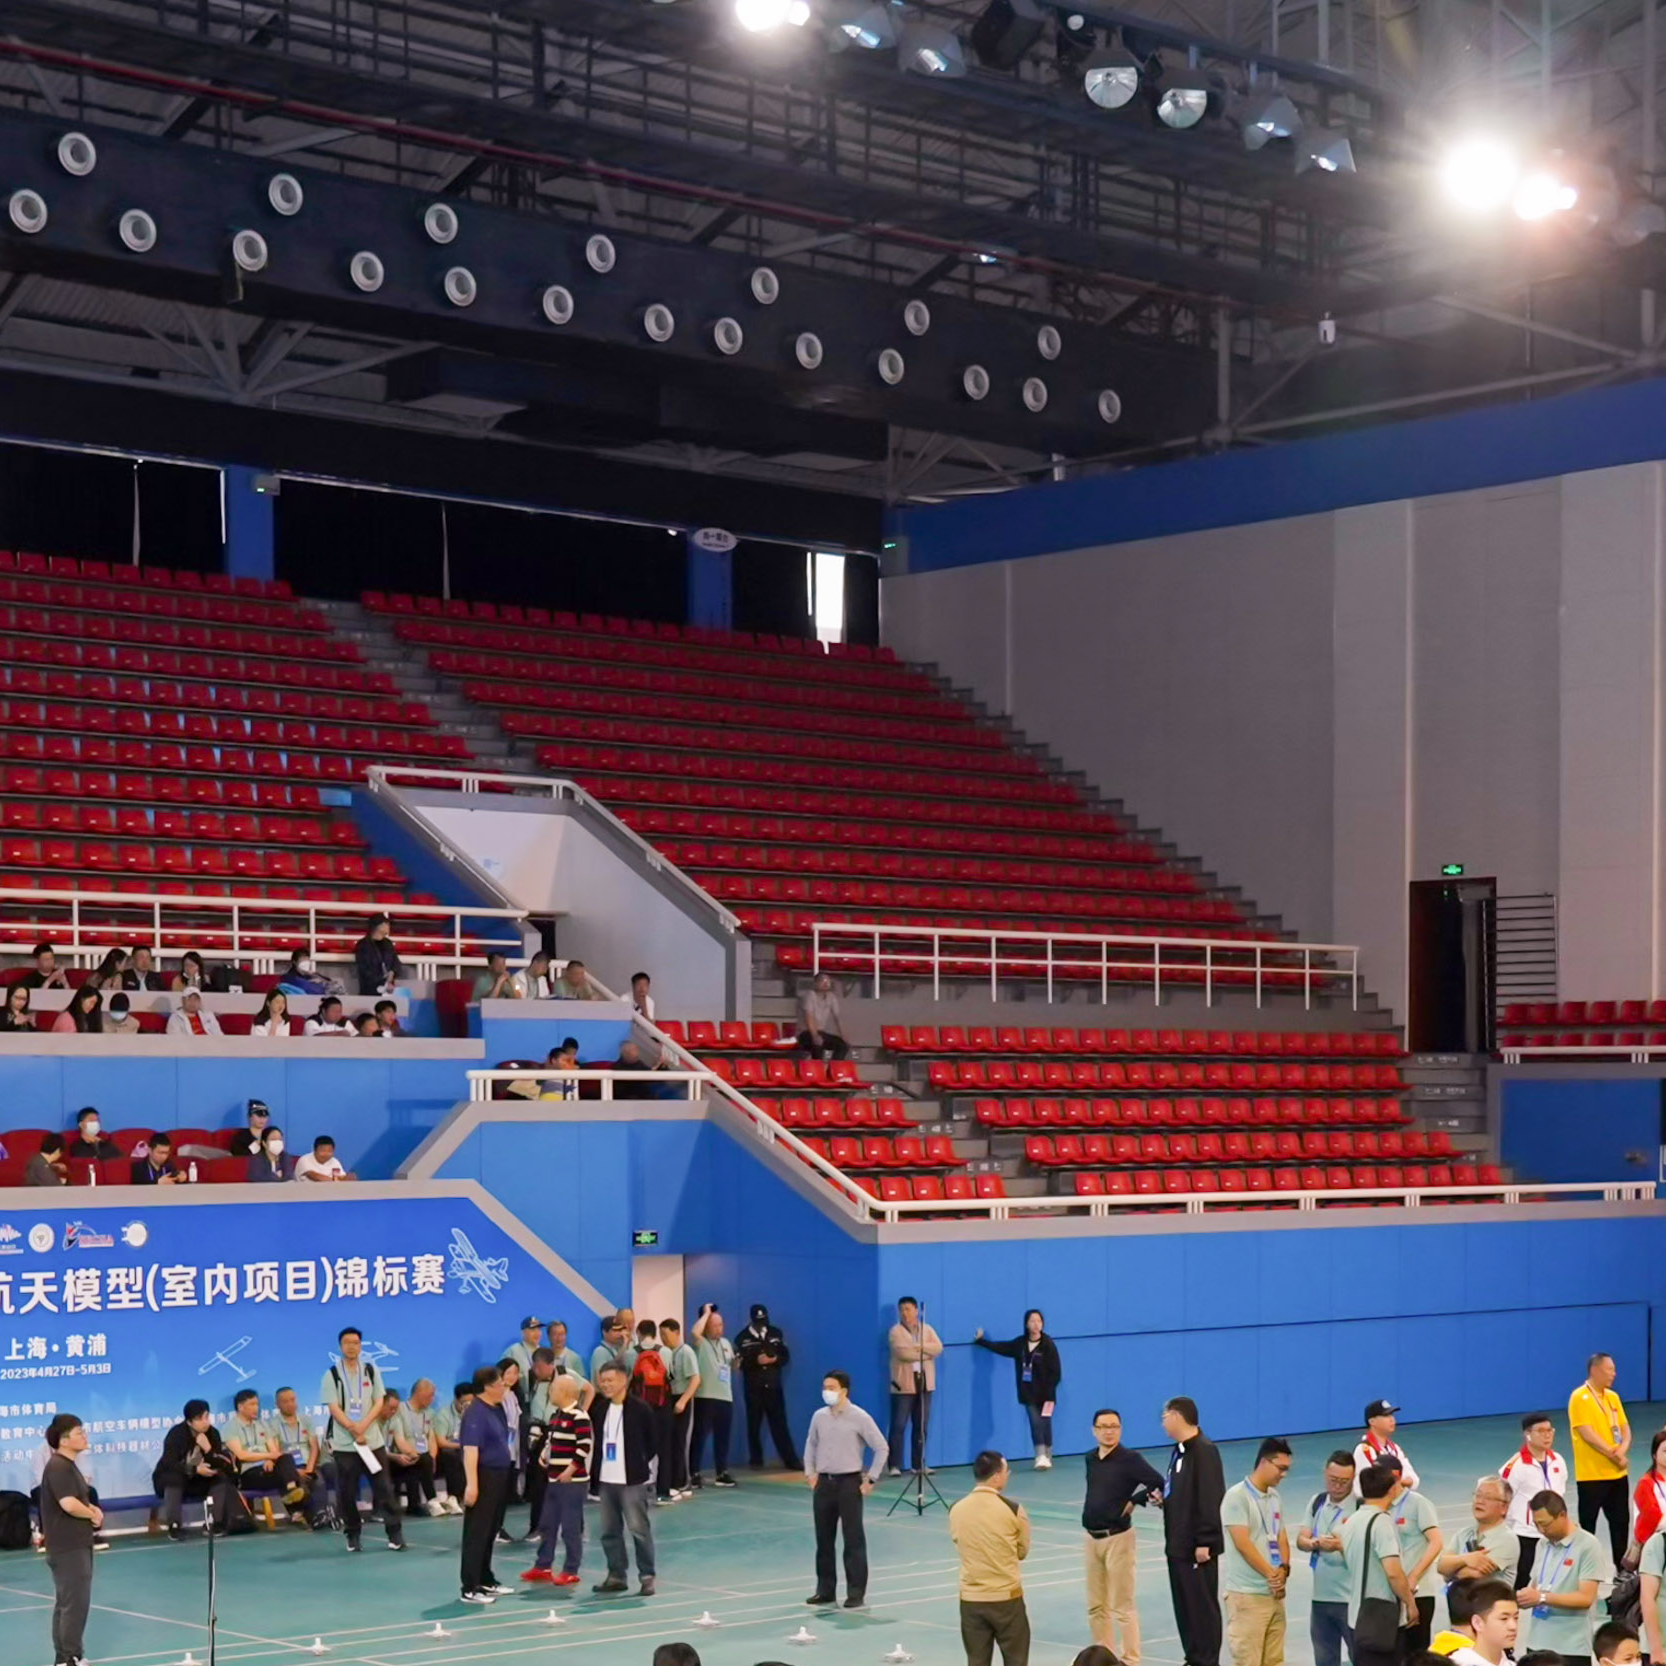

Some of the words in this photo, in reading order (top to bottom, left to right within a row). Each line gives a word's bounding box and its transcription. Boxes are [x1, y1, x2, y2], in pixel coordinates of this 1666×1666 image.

[0, 1363, 111, 1381] 2023年4月27日-5月3日
